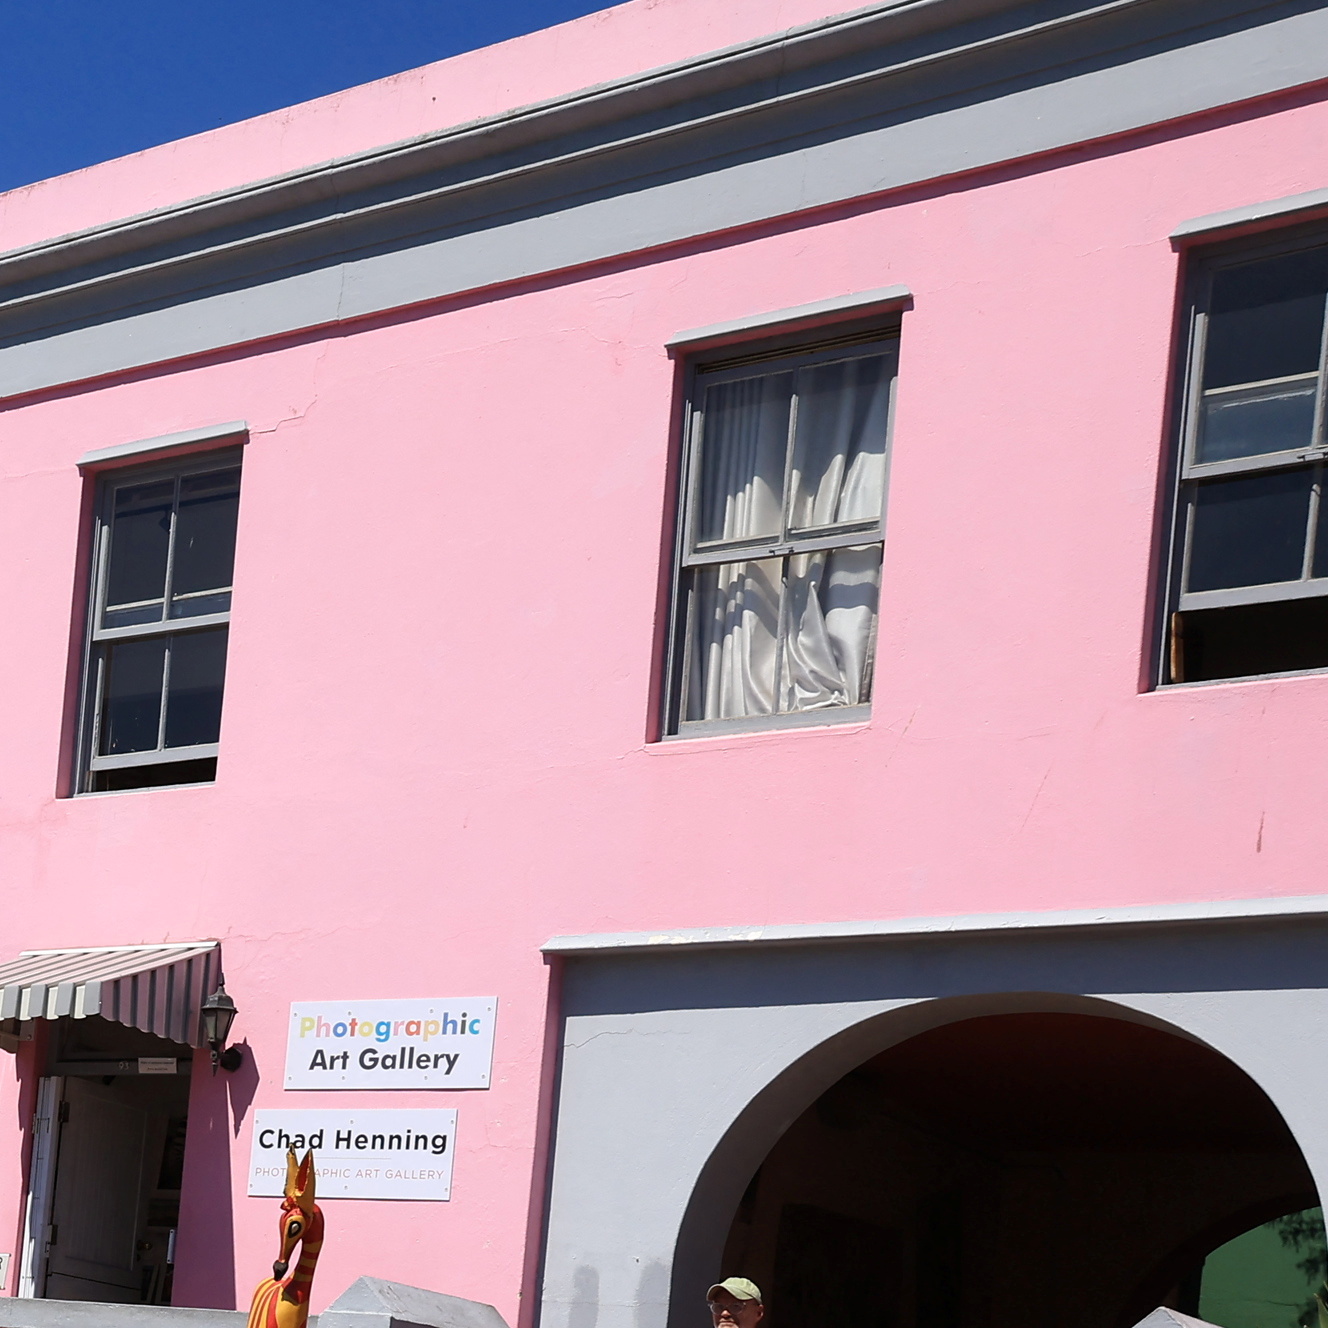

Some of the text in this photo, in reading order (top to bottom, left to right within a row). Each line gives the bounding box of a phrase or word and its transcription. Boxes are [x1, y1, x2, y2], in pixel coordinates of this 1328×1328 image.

[299, 1012, 481, 1043] Photographic
[308, 1047, 460, 1076] Art Gallery
[258, 1128, 448, 1155] Chad Henning
[255, 1167, 445, 1180] PHOTAPHIC ART GALLERY
